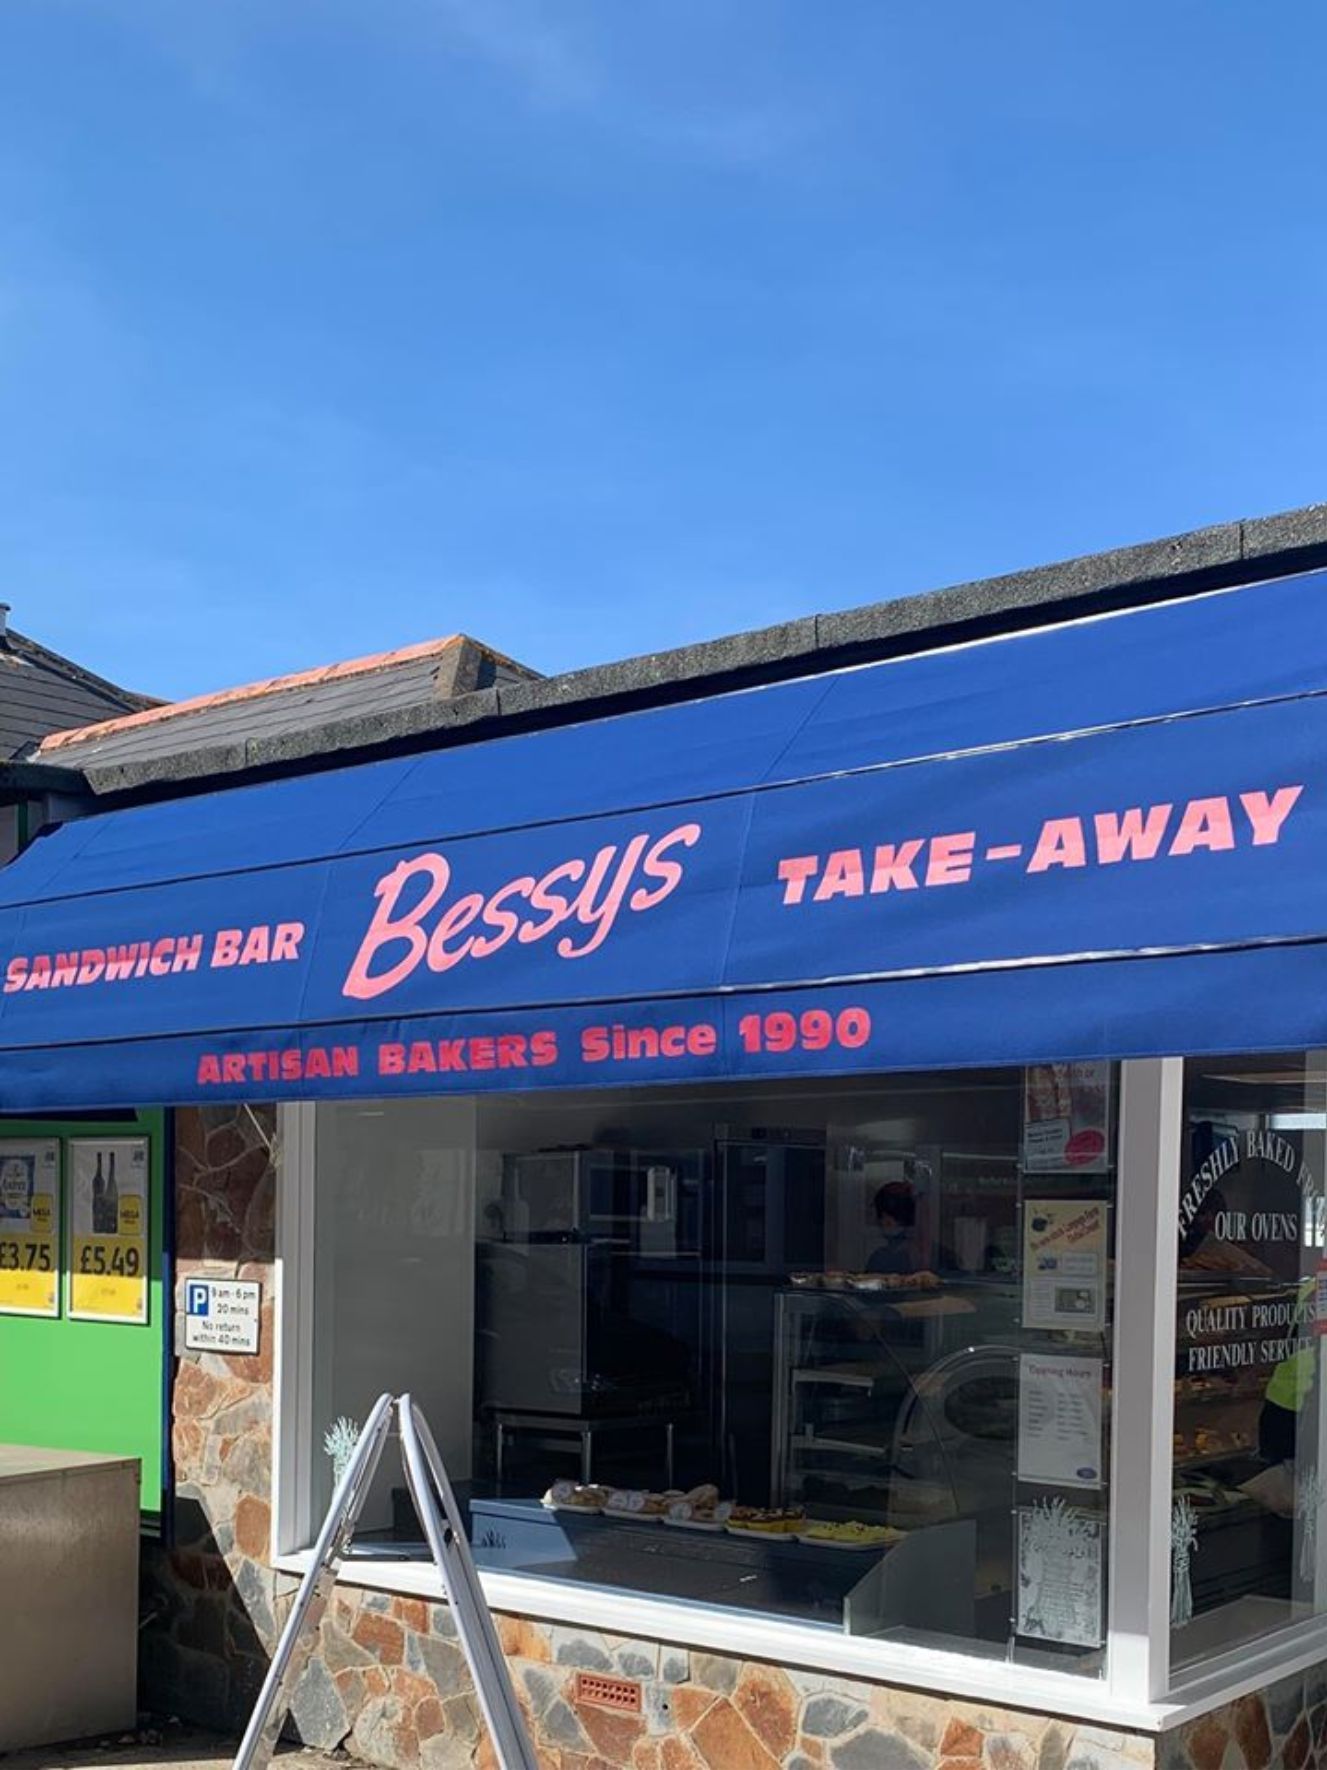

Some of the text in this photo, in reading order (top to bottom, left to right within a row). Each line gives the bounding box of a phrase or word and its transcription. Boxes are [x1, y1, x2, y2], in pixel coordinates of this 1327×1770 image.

[777, 785, 1303, 905] TAKE-AWAY
[342, 823, 701, 1001] Bessys
[4, 922, 304, 993] SANDWICH BAR
[197, 1007, 872, 1085] ARTISAN BAKERS Since 1990
[1178, 1134, 1241, 1240] FRESHLY
[1246, 1130, 1296, 1173] BAKED
[1214, 1211, 1298, 1241] OUR OVENS
[0, 1242, 51, 1272] £3.75
[80, 1245, 140, 1277] £5.49
[1186, 1305, 1248, 1338] QUALITY
[1188, 1341, 1257, 1372] FRIENDLY
